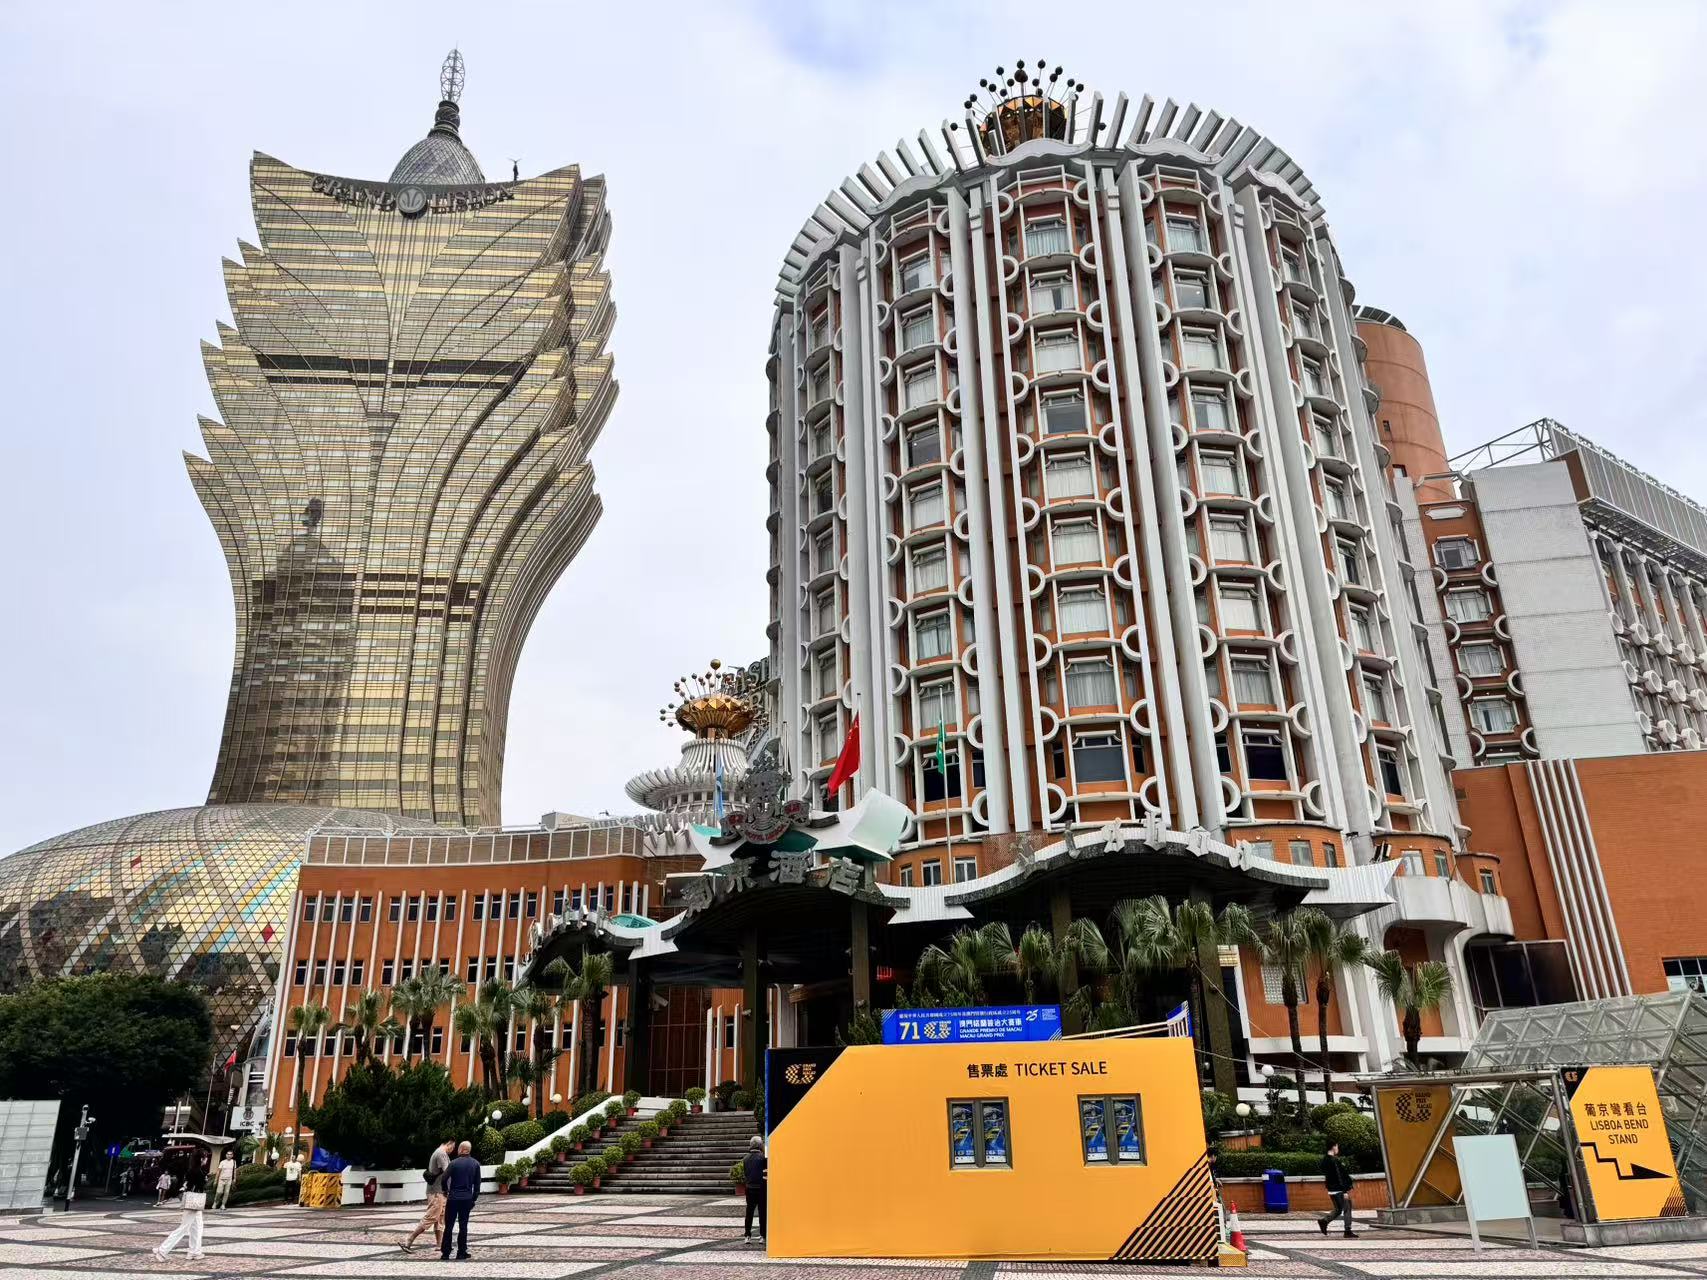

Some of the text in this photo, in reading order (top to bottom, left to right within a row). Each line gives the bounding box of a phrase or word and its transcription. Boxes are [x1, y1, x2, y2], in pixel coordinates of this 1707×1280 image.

[311, 176, 514, 210] GRAND LISBOA
[899, 1021, 920, 1040] 71
[967, 1061, 1108, 1078] 售票處 TICKET SALE
[1590, 1119, 1649, 1131] LISBOA BEND
[1608, 1133, 1638, 1144] STAND
